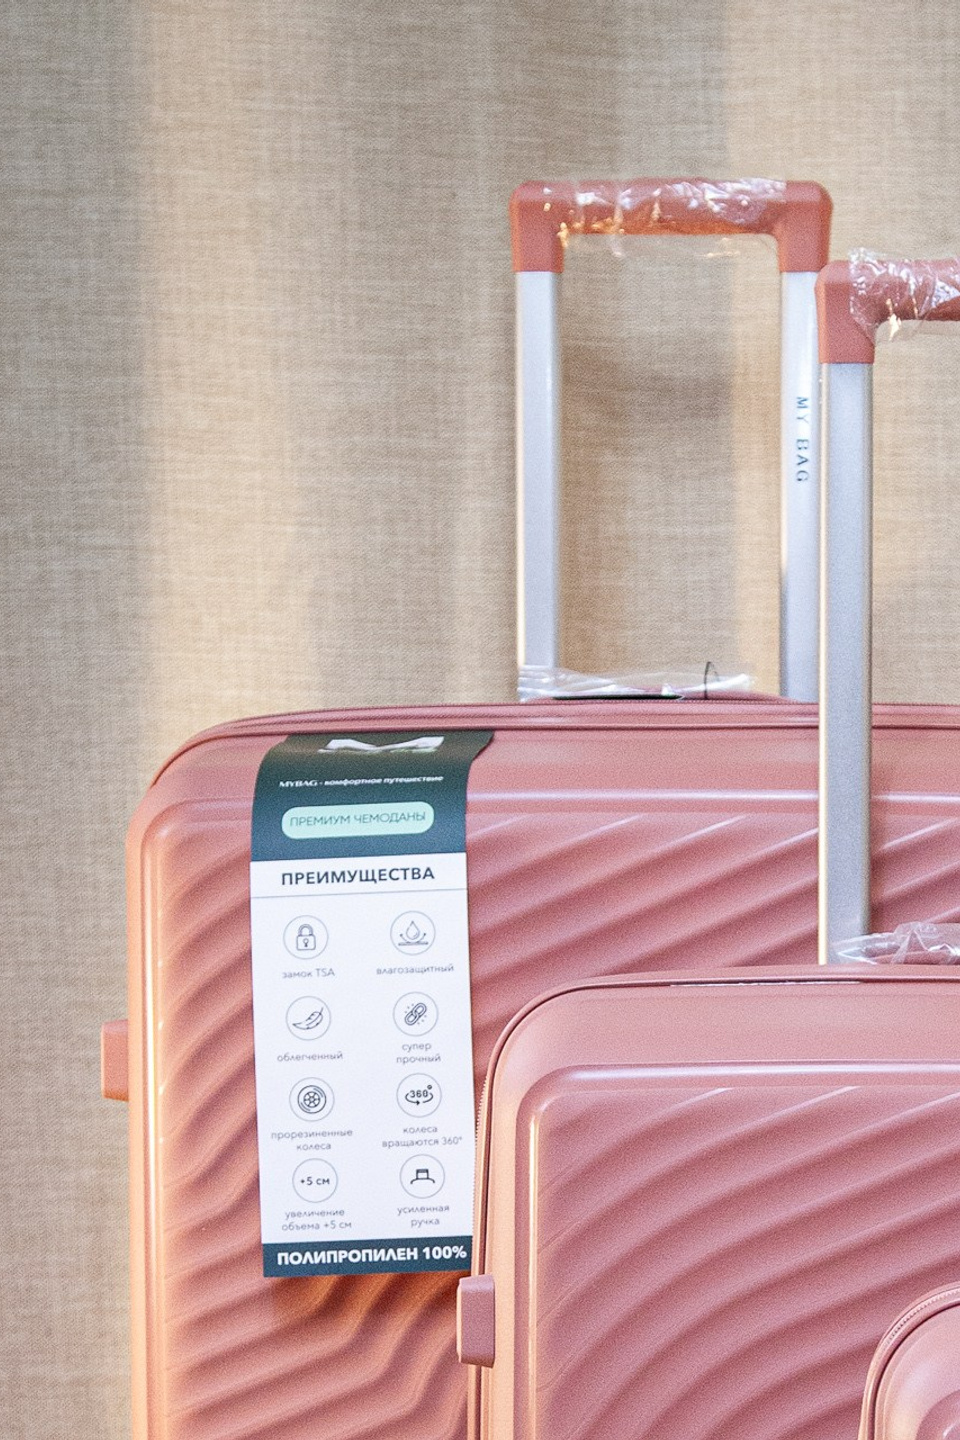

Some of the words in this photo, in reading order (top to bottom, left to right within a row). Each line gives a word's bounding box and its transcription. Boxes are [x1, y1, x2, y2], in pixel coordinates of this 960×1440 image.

[796, 397, 809, 423] MY
[796, 439, 809, 481] BAG
[280, 779, 318, 788] MYBAG
[324, 777, 382, 787] комфортное
[384, 776, 444, 786] путешествие
[290, 814, 350, 826] ПРЕМИУМ
[354, 812, 426, 824] ЧЕМОДАНЫ
[282, 867, 434, 886] ПРЕИМУЩЕСТВА
[282, 970, 312, 978] замок
[315, 968, 335, 976] TSA
[376, 964, 454, 976] влагозащитный
[402, 1042, 432, 1052] супер
[277, 1052, 343, 1062] облегченный
[396, 1054, 441, 1065] прочный
[272, 1128, 352, 1140] прорезиненные
[403, 1125, 438, 1134] колеса
[296, 1142, 331, 1150] колеса
[382, 1138, 439, 1149] вращаются
[300, 1177, 313, 1186] +5
[285, 1209, 344, 1219] увеличение
[398, 1205, 450, 1214] усиленная
[282, 1222, 320, 1230] объема
[411, 1218, 440, 1228] ручка
[278, 1248, 418, 1266] ПОЛИПРОПИЛЕН
[422, 1246, 467, 1260] 100%
